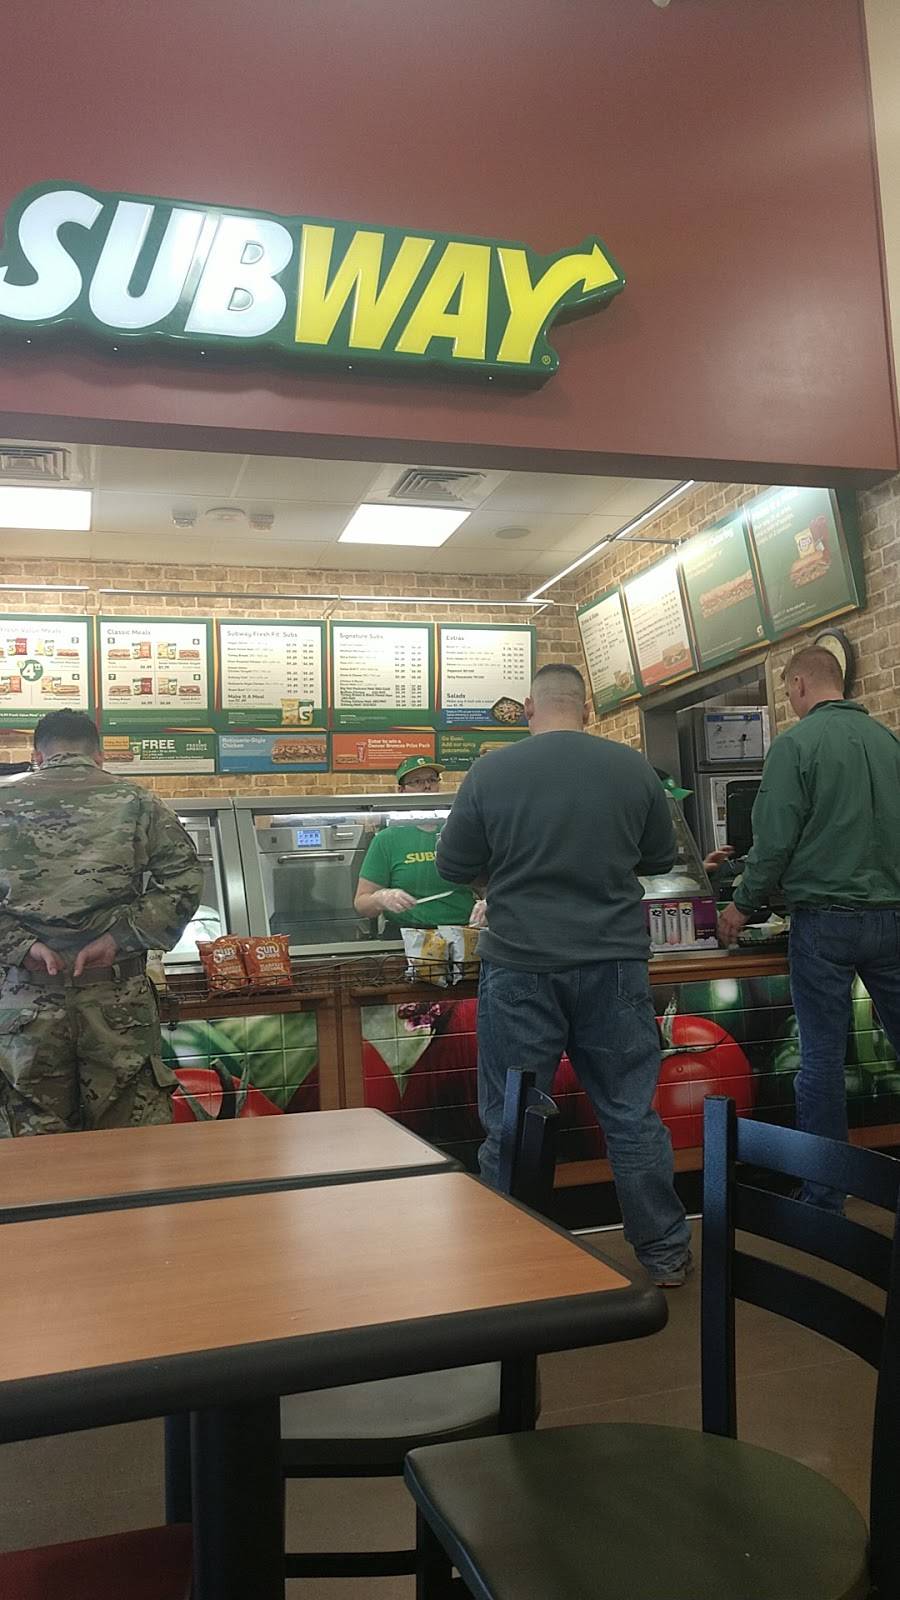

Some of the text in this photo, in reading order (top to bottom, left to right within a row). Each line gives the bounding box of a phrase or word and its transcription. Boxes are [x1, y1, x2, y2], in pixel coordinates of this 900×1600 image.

[0, 190, 618, 363] SUBWAY
[227, 630, 252, 638] Subway
[142, 739, 176, 750] FREE
[404, 851, 437, 864] SUB
